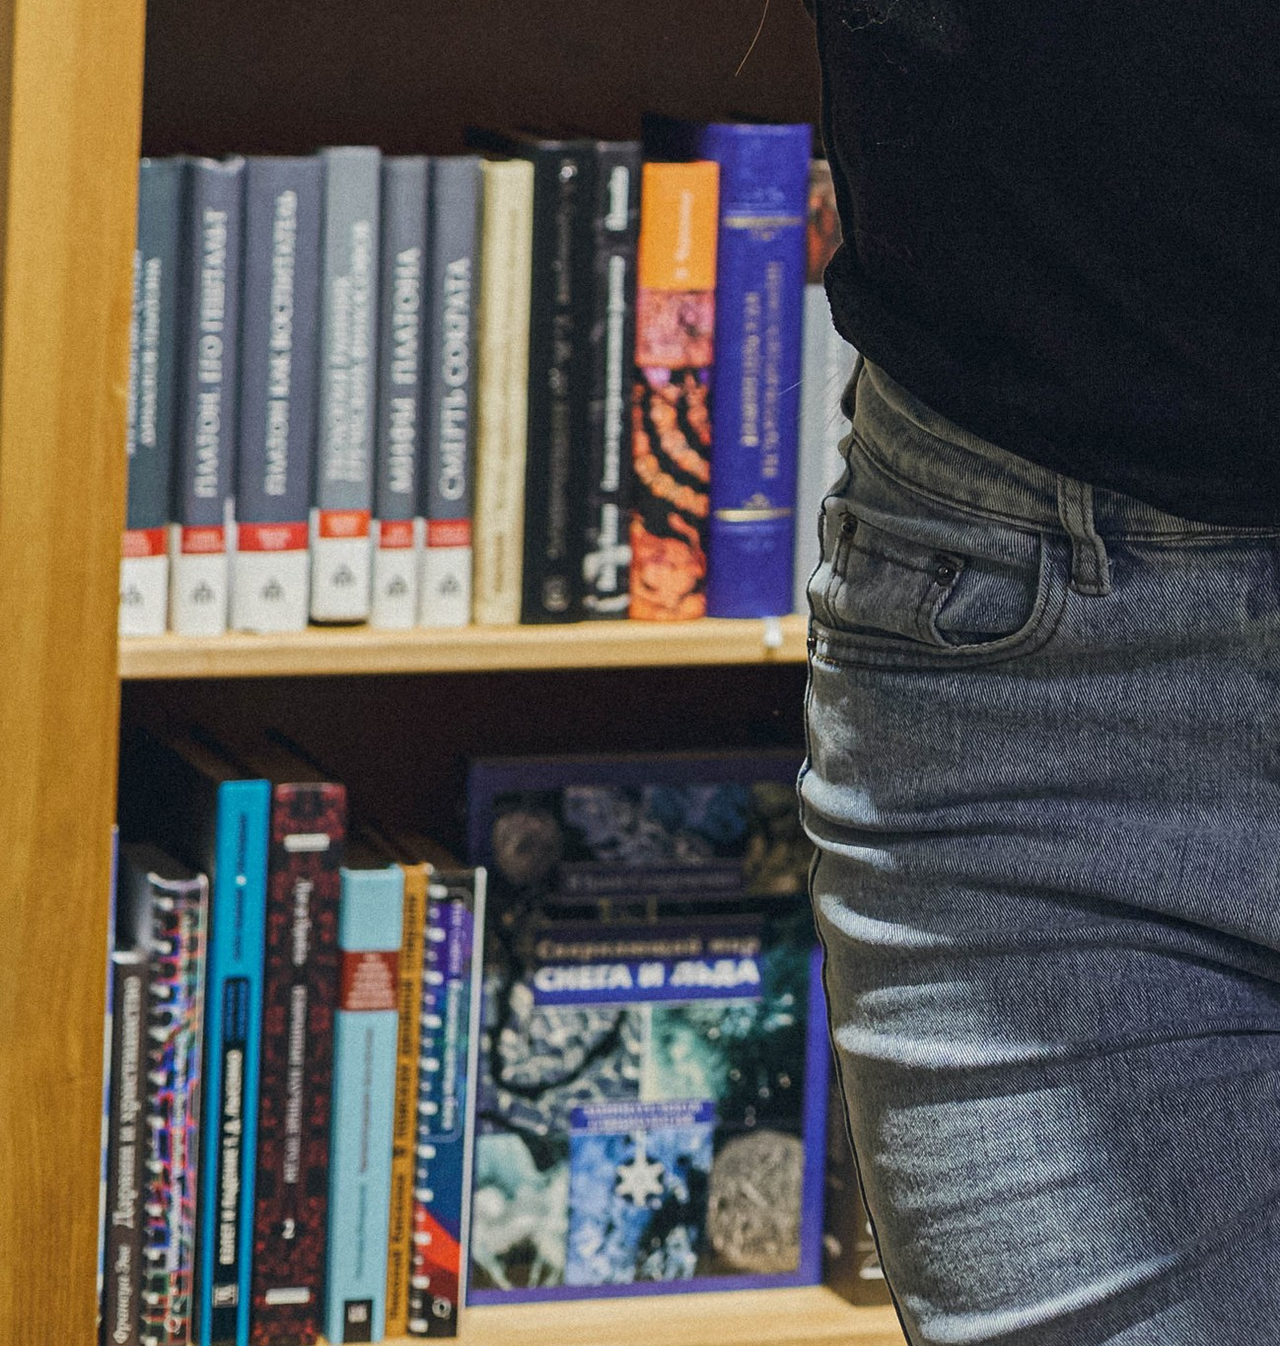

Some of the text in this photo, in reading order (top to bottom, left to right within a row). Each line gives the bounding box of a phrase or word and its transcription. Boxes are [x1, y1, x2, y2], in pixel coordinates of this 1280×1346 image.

[197, 334, 221, 383] ЕГО
[264, 189, 298, 496] ПЛАТОН КАК ВОСПИТАТЕЛЬ
[389, 248, 421, 494] МИФЫ ПЛАТОНА
[438, 257, 471, 501] СМЕРТЬ СОКРАТА
[534, 957, 762, 993] СНЕГА И ЛЬДА
[110, 975, 142, 1230] Дарвин и христианство
